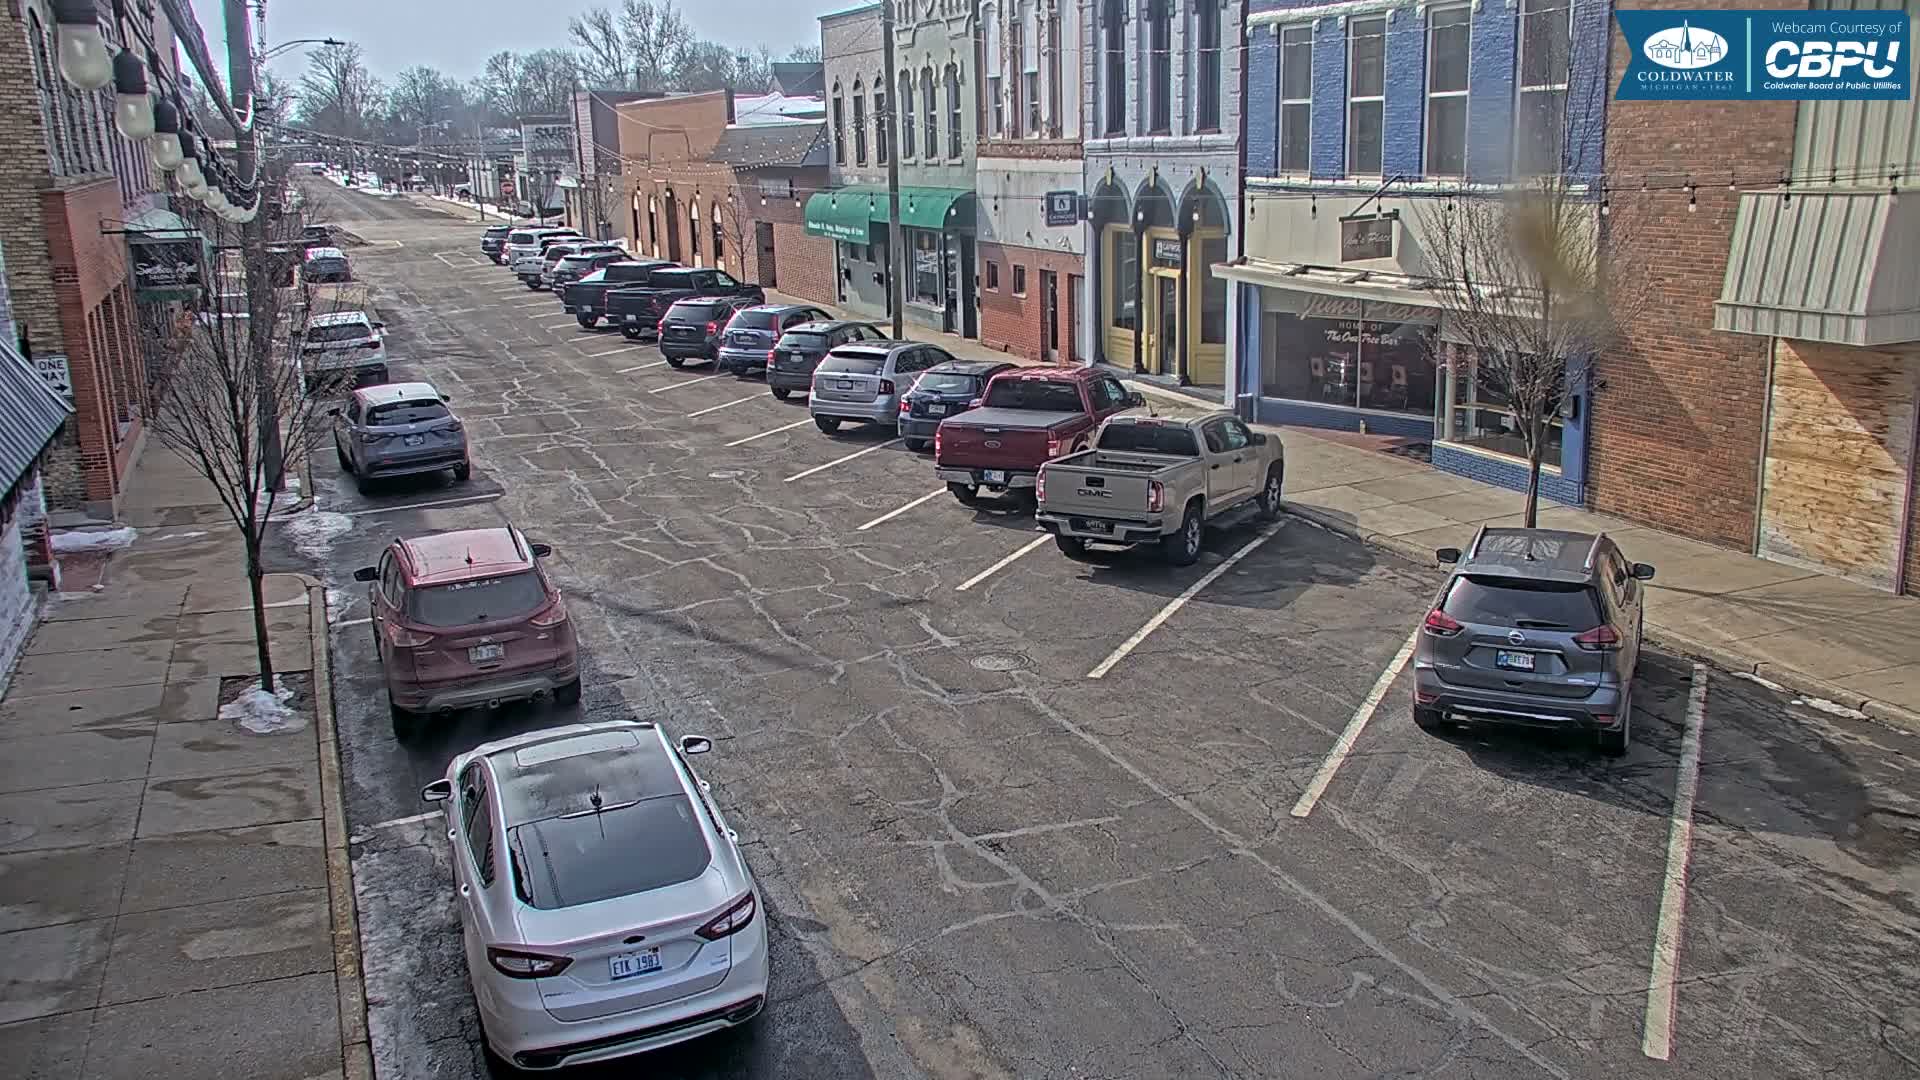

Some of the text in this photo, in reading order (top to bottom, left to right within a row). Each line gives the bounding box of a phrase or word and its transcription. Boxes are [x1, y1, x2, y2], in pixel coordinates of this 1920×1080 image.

[1338, 321, 1384, 332] HOME OF
[39, 360, 65, 370] ONE
[1077, 488, 1113, 499] GMC
